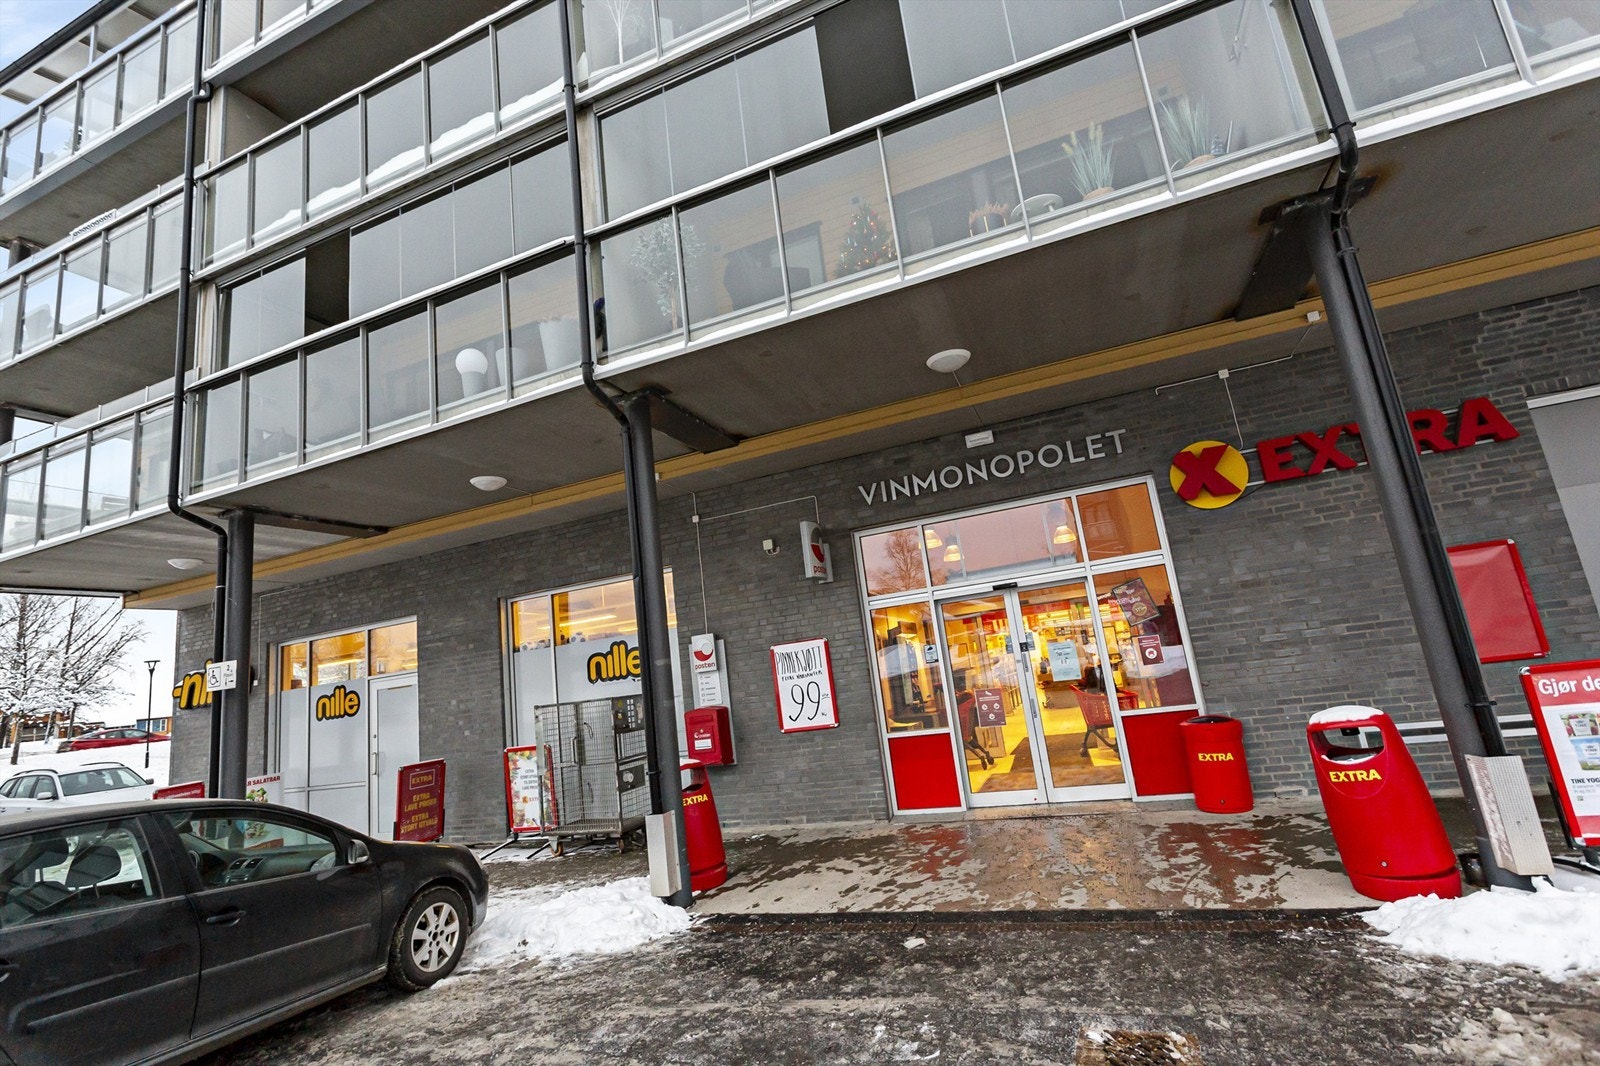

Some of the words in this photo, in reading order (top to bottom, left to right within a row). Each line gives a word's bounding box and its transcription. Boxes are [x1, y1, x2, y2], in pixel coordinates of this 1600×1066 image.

[1257, 397, 1521, 483] EXRA
[858, 429, 1126, 506] VINMONOPOLET
[695, 662, 715, 670] posten
[1538, 678, 1577, 697] Gjør
[316, 685, 361, 721] nille
[789, 681, 820, 722] 99
[1198, 752, 1234, 761] EXTRA
[252, 775, 281, 786] SALATBAR
[411, 775, 433, 785] EXTRA
[1329, 769, 1382, 782] EXTRA
[413, 792, 430, 802] EXTRA
[683, 794, 709, 806] EXTRA
[411, 812, 429, 823] EXTRA
